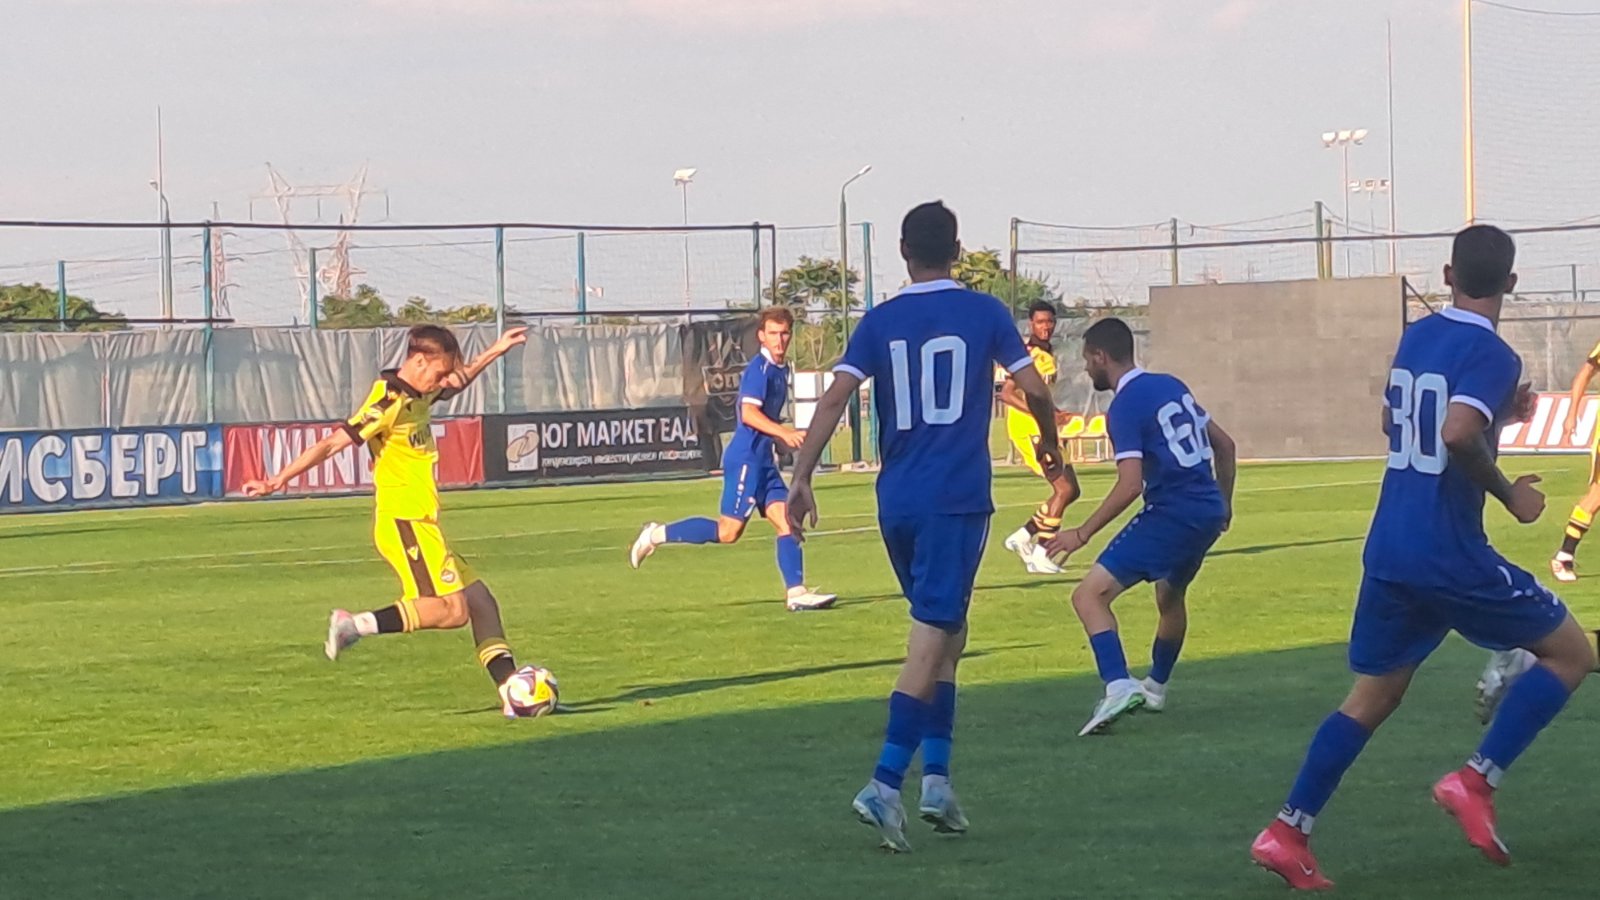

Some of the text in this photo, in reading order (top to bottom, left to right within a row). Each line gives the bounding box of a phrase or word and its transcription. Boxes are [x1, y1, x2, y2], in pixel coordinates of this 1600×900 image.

[889, 335, 967, 430] 10
[1387, 369, 1448, 475] 30
[541, 416, 699, 449] ЮГ МАРКЕТ ЕАД
